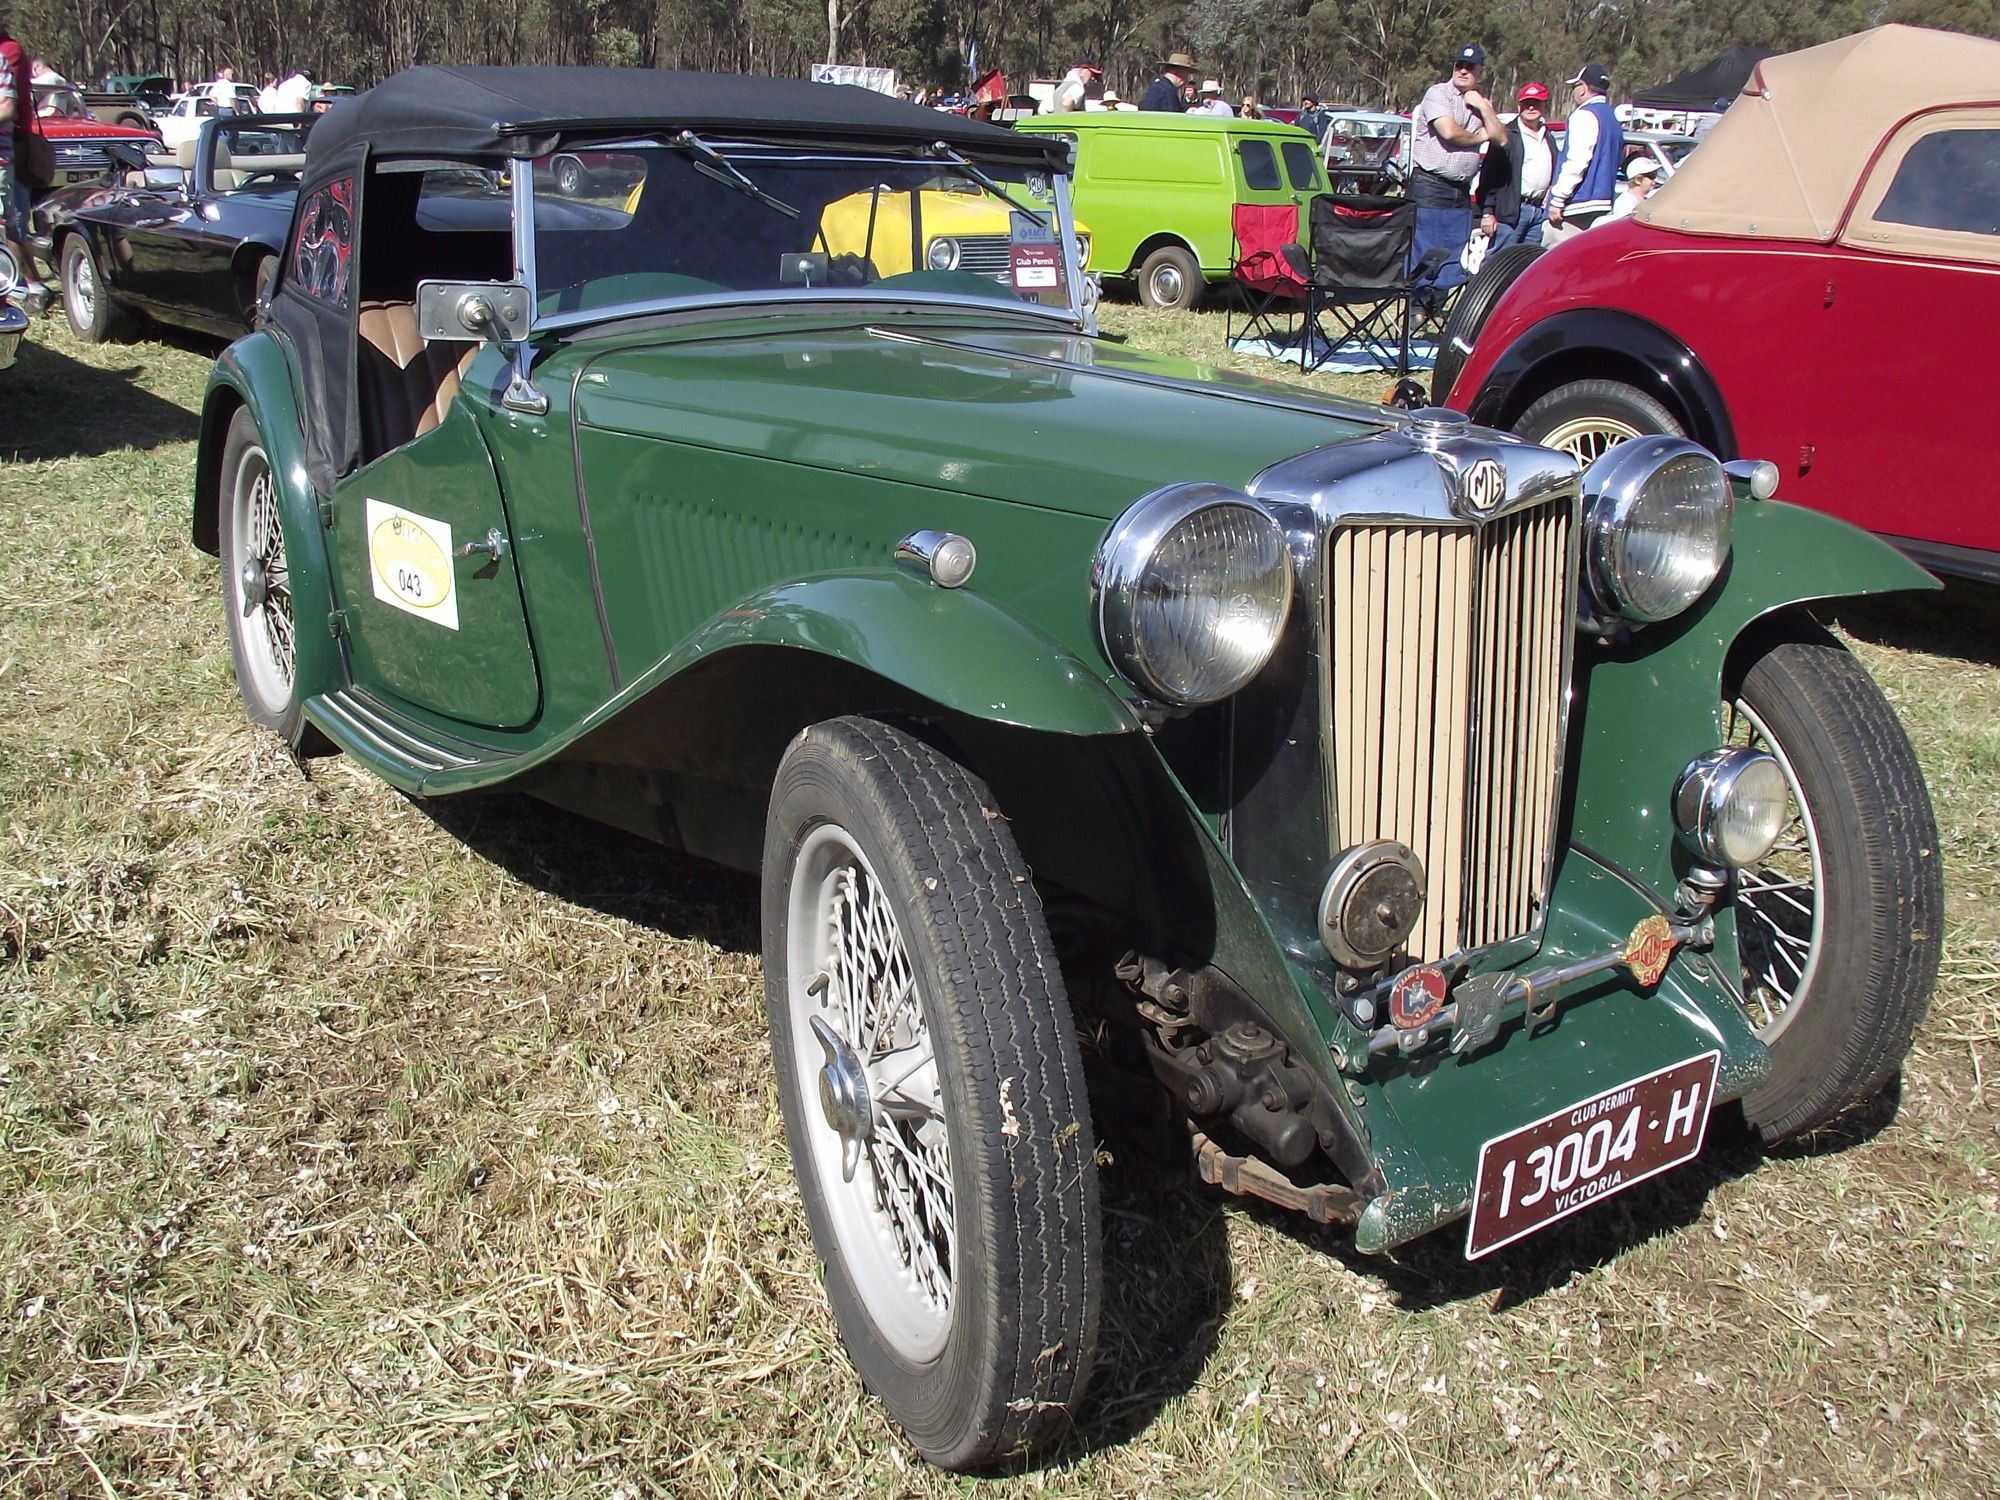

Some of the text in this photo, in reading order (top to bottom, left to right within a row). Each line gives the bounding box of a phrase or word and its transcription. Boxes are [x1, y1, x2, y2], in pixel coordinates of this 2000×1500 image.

[1016, 258, 1054, 266] Club Permit
[1474, 465, 1502, 505] MG
[399, 569, 421, 597] 043
[1641, 935, 1662, 966] MG
[1643, 968, 1659, 986] 50
[1570, 1087, 1636, 1127] CLUB PERMIT
[1554, 1169, 1622, 1213] VICTORIA
